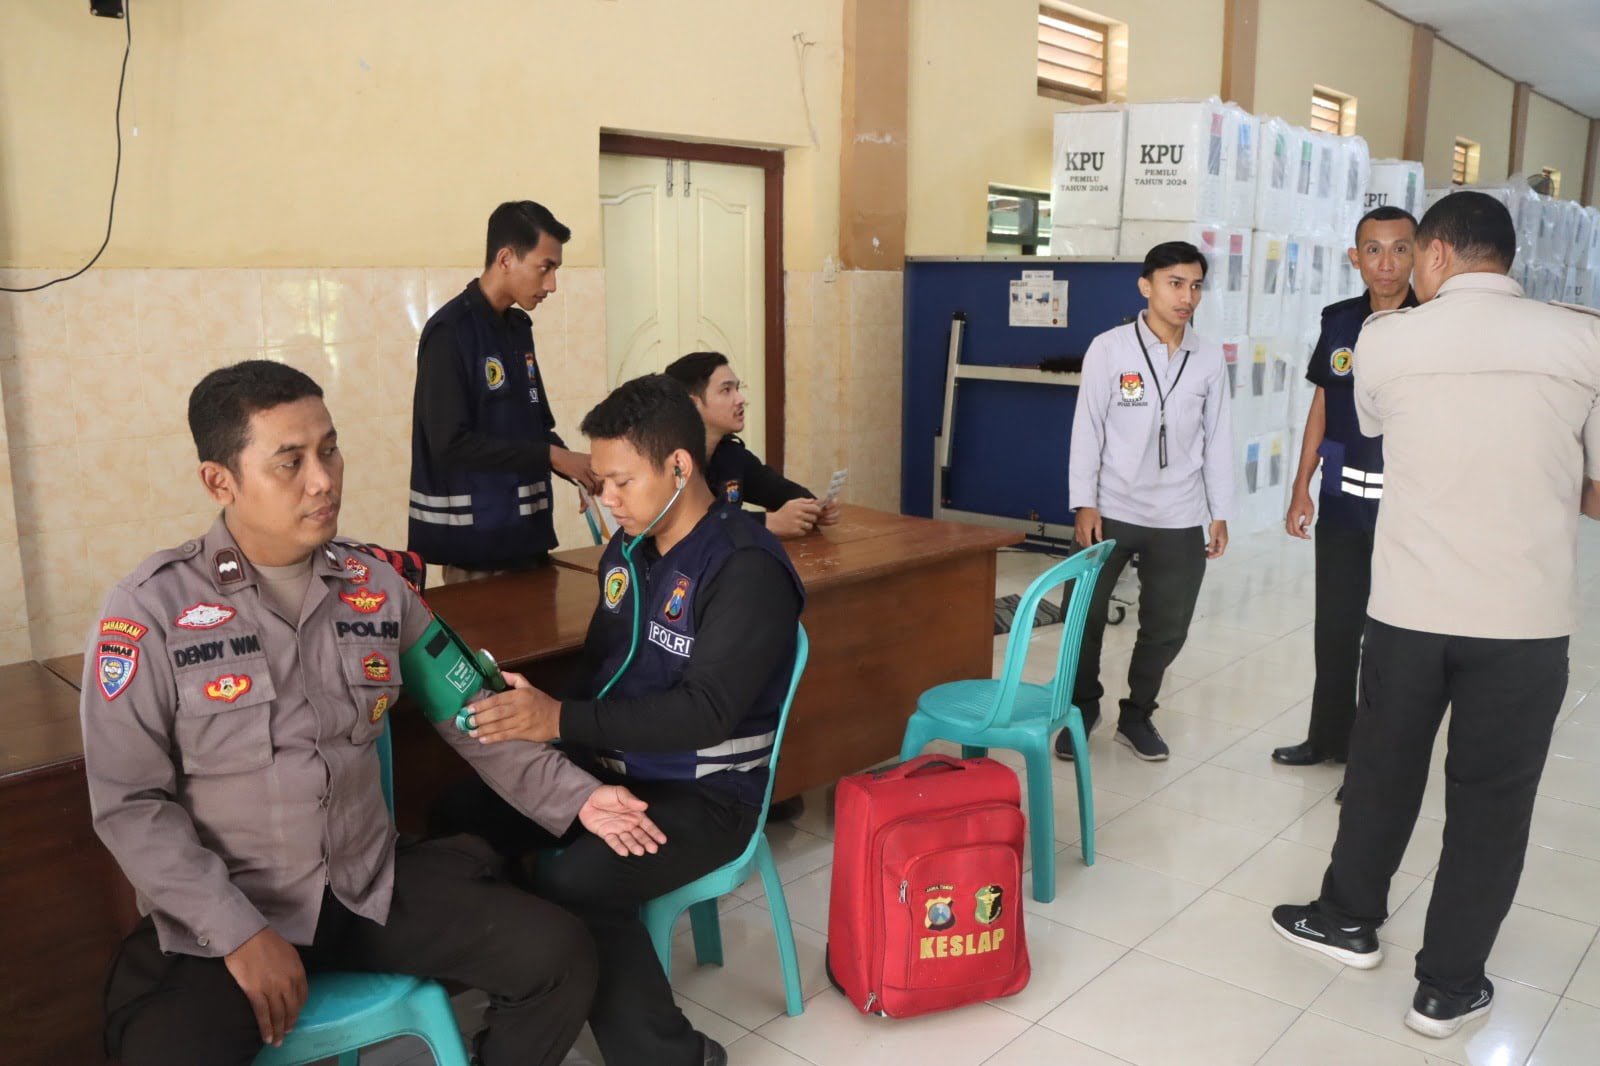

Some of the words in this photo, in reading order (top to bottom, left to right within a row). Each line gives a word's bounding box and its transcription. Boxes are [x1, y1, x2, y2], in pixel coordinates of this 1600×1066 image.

[1065, 151, 1105, 171] KPU
[1139, 144, 1184, 165] KPU
[1166, 178, 1187, 186] 2024
[336, 620, 399, 640] POLRI
[652, 625, 691, 654] POLRI
[174, 640, 224, 668] DENDY
[230, 634, 261, 657] WM
[919, 927, 1005, 959] KESLAP
